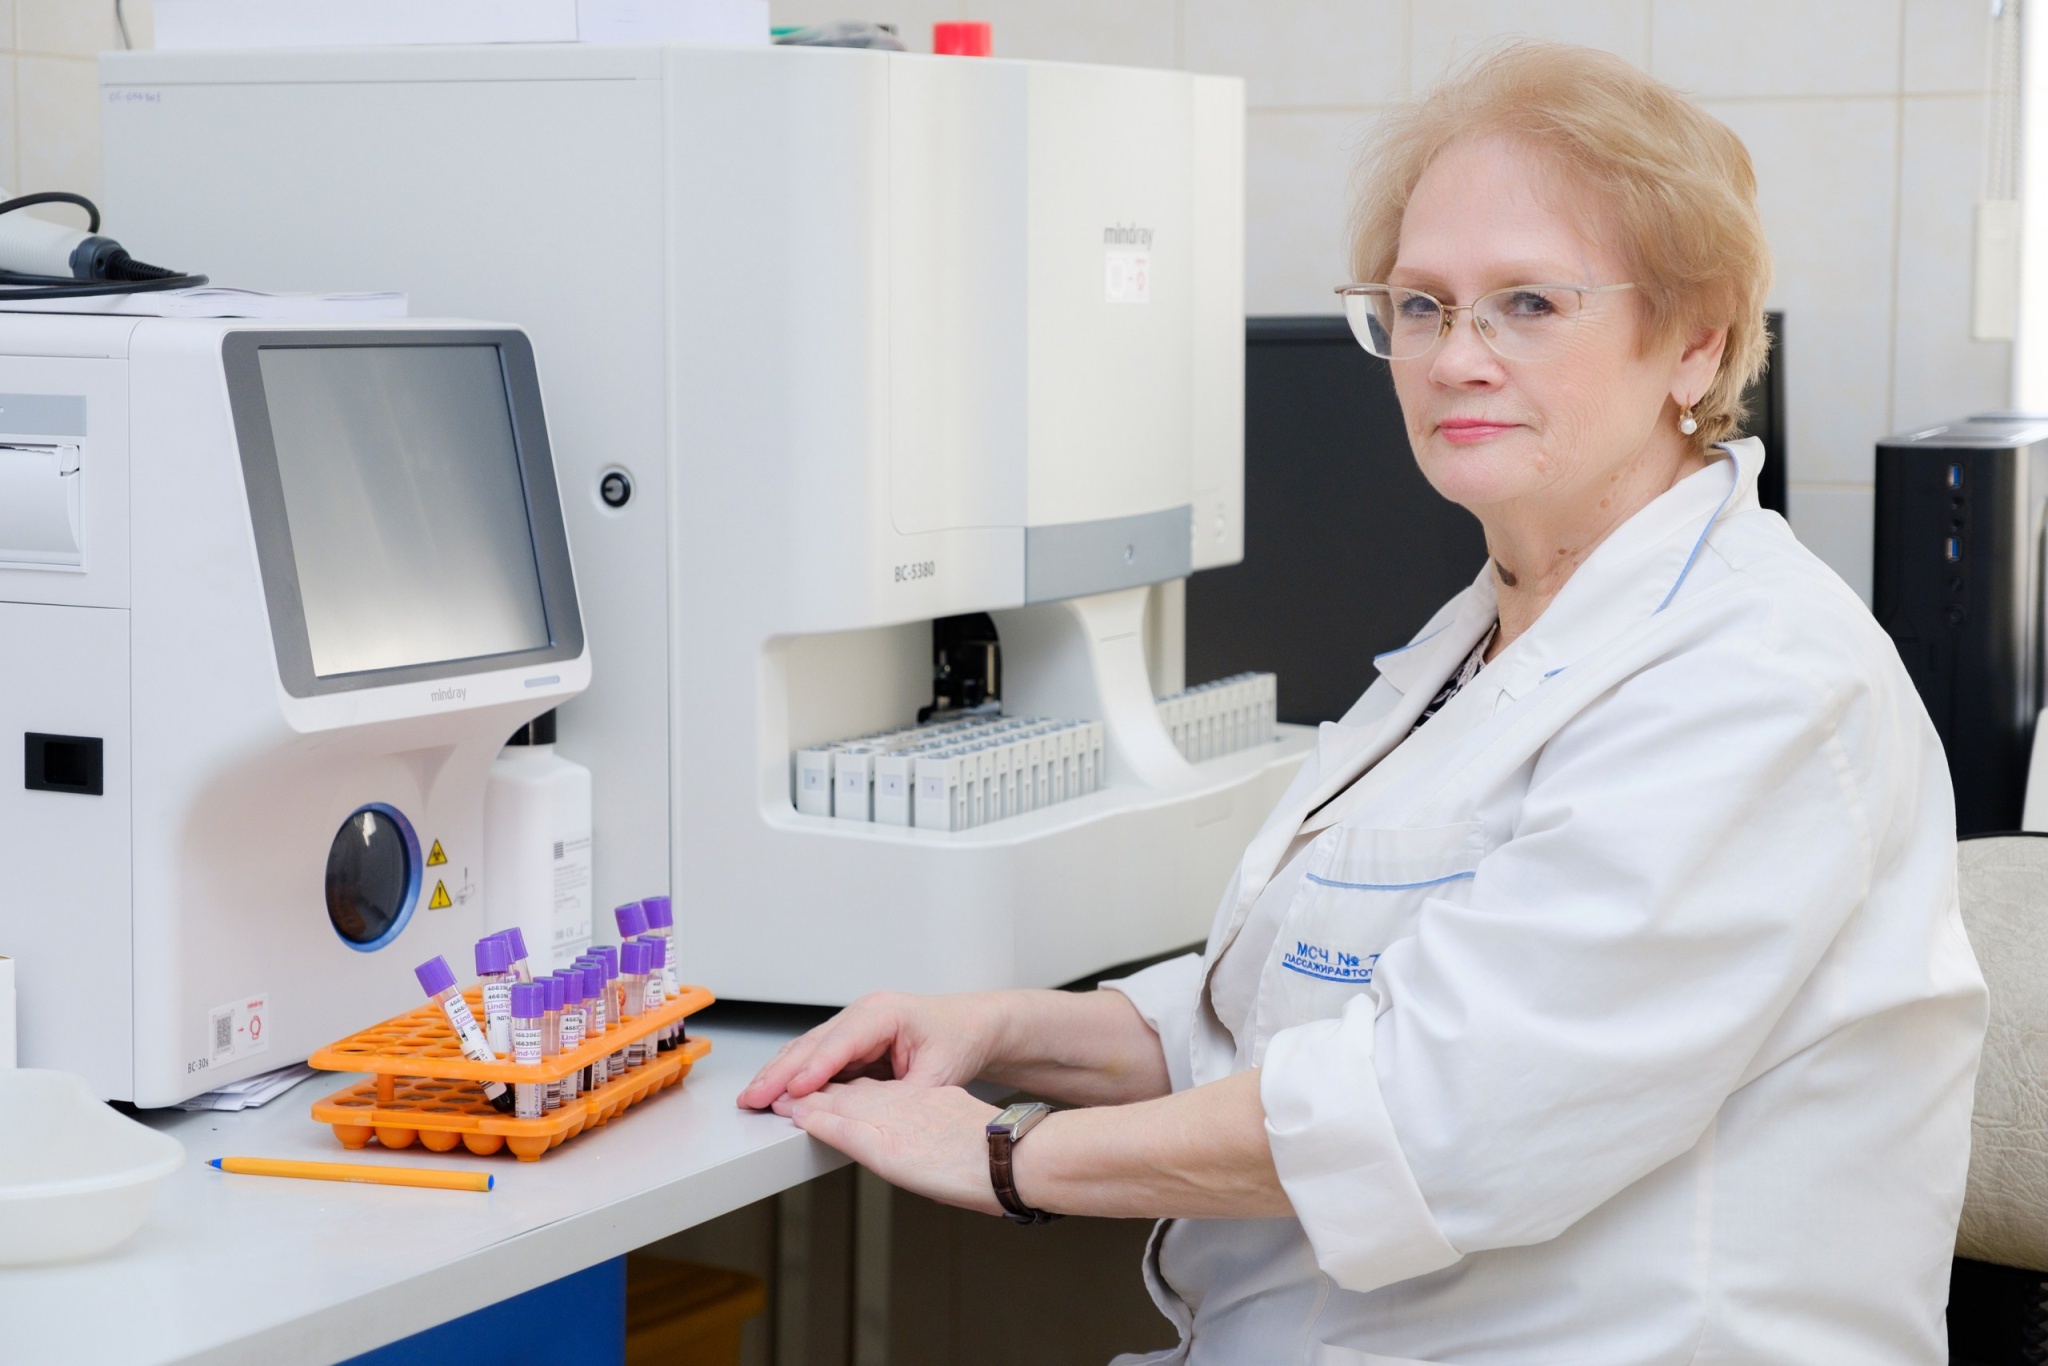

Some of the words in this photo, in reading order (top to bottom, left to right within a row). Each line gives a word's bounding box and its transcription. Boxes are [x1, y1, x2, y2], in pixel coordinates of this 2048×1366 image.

[1103, 221, 1155, 252] mindray
[894, 560, 936, 583] BC-5380
[430, 686, 467, 702] mindray
[1296, 941, 1329, 963] МСЧ
[1338, 951, 1360, 967] №
[187, 1058, 209, 1074] BC-30s
